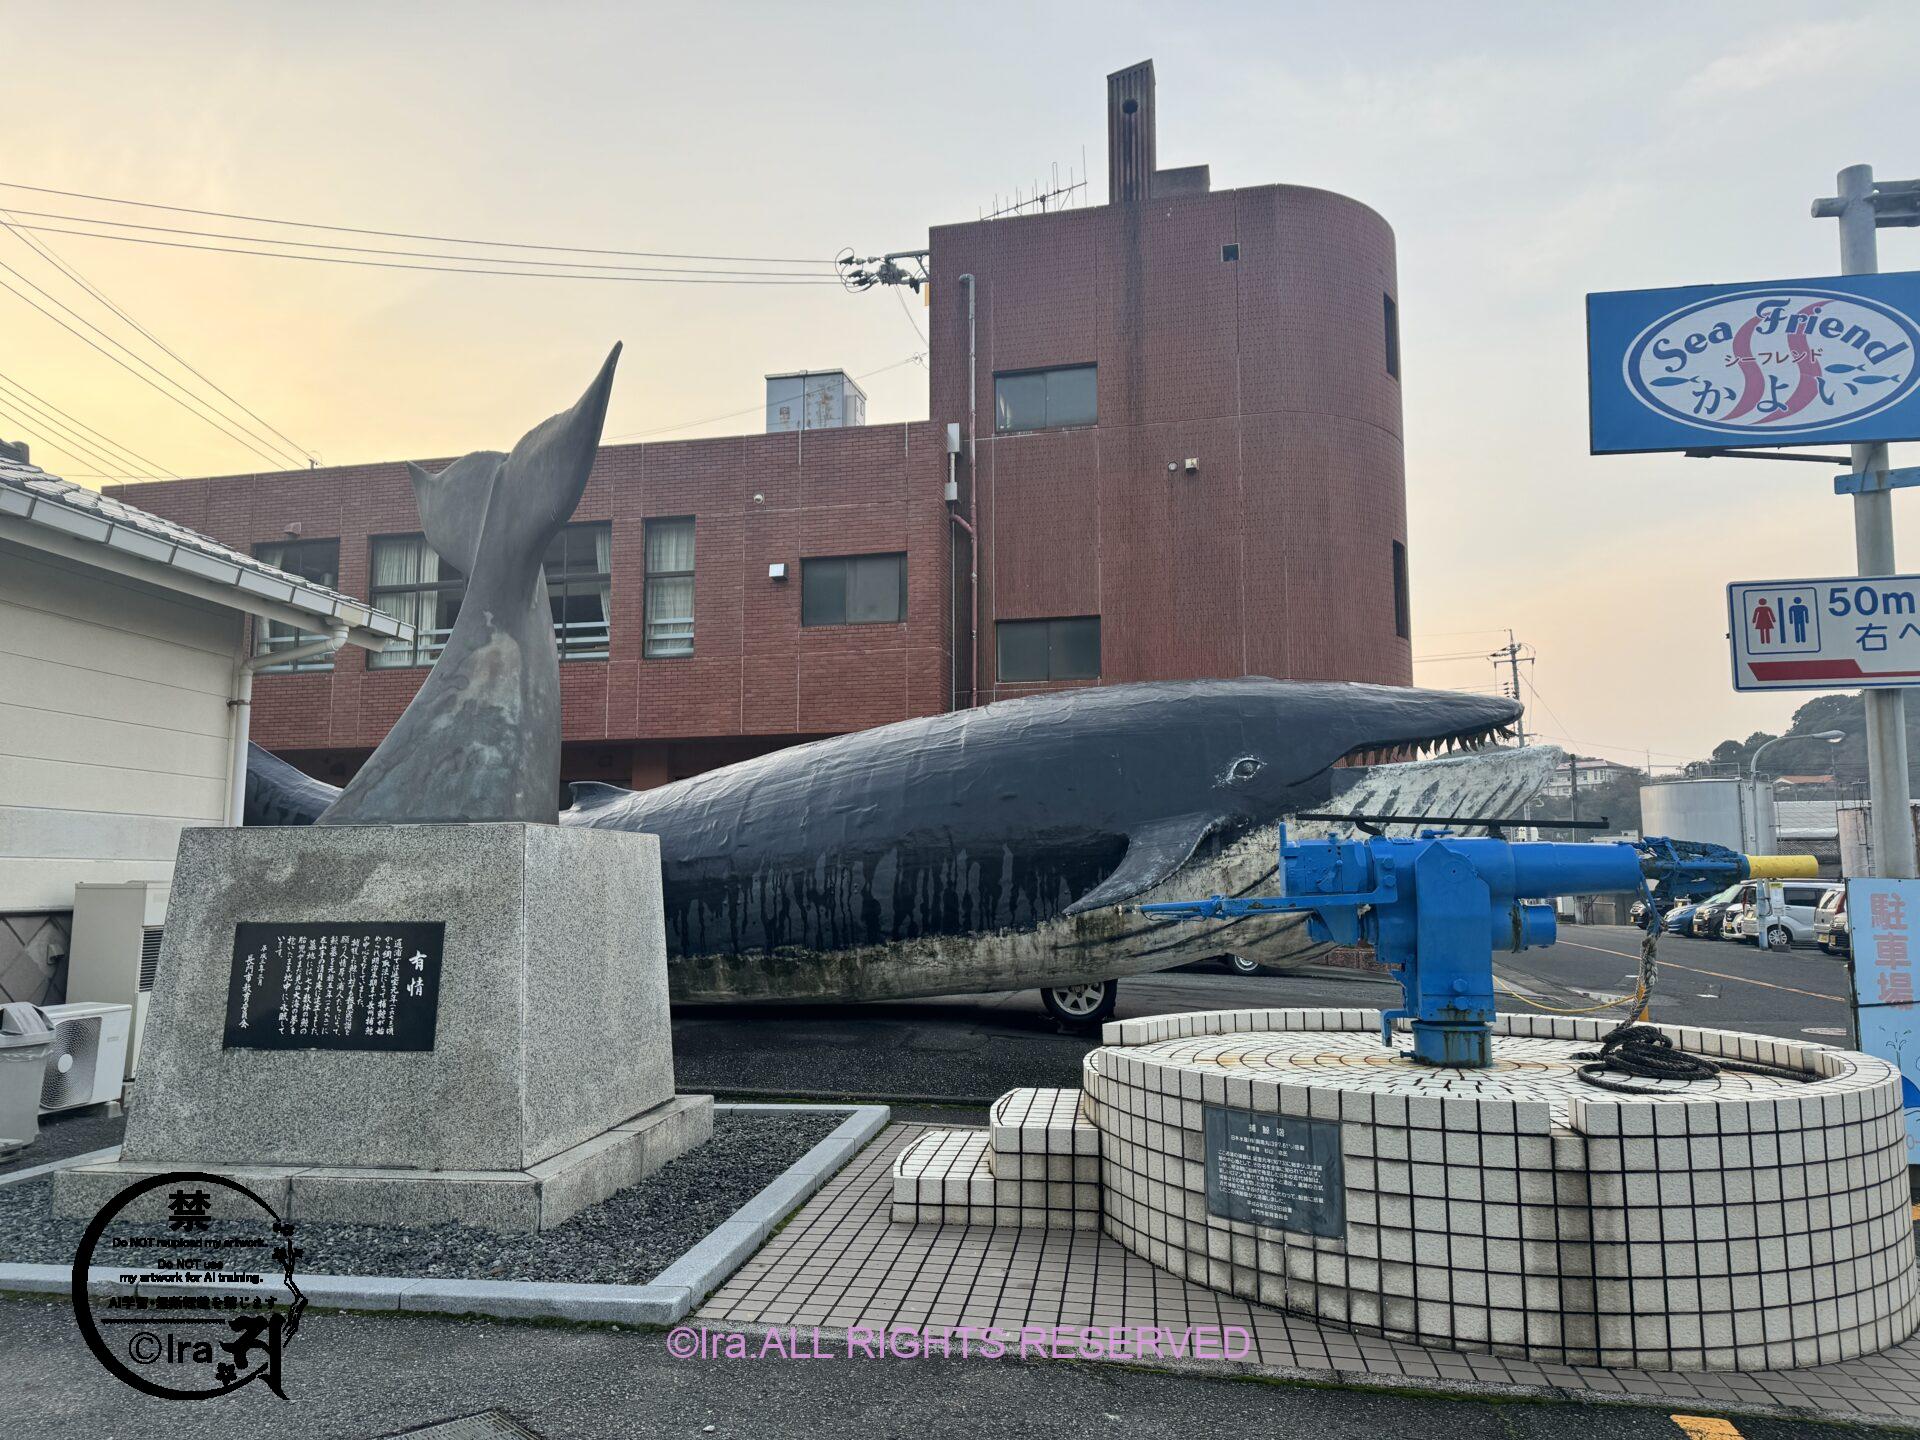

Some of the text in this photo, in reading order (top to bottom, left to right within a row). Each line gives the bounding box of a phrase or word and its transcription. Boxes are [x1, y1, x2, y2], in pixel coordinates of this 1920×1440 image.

[1652, 298, 1910, 373] Sea Friend
[1724, 348, 1824, 368] シーフレンド
[1691, 374, 1858, 415] かよい
[1828, 585, 1916, 617] 50m
[1855, 622, 1920, 652] 右へ
[1869, 892, 1914, 1012] 駐車場
[406, 949, 428, 998] 有情
